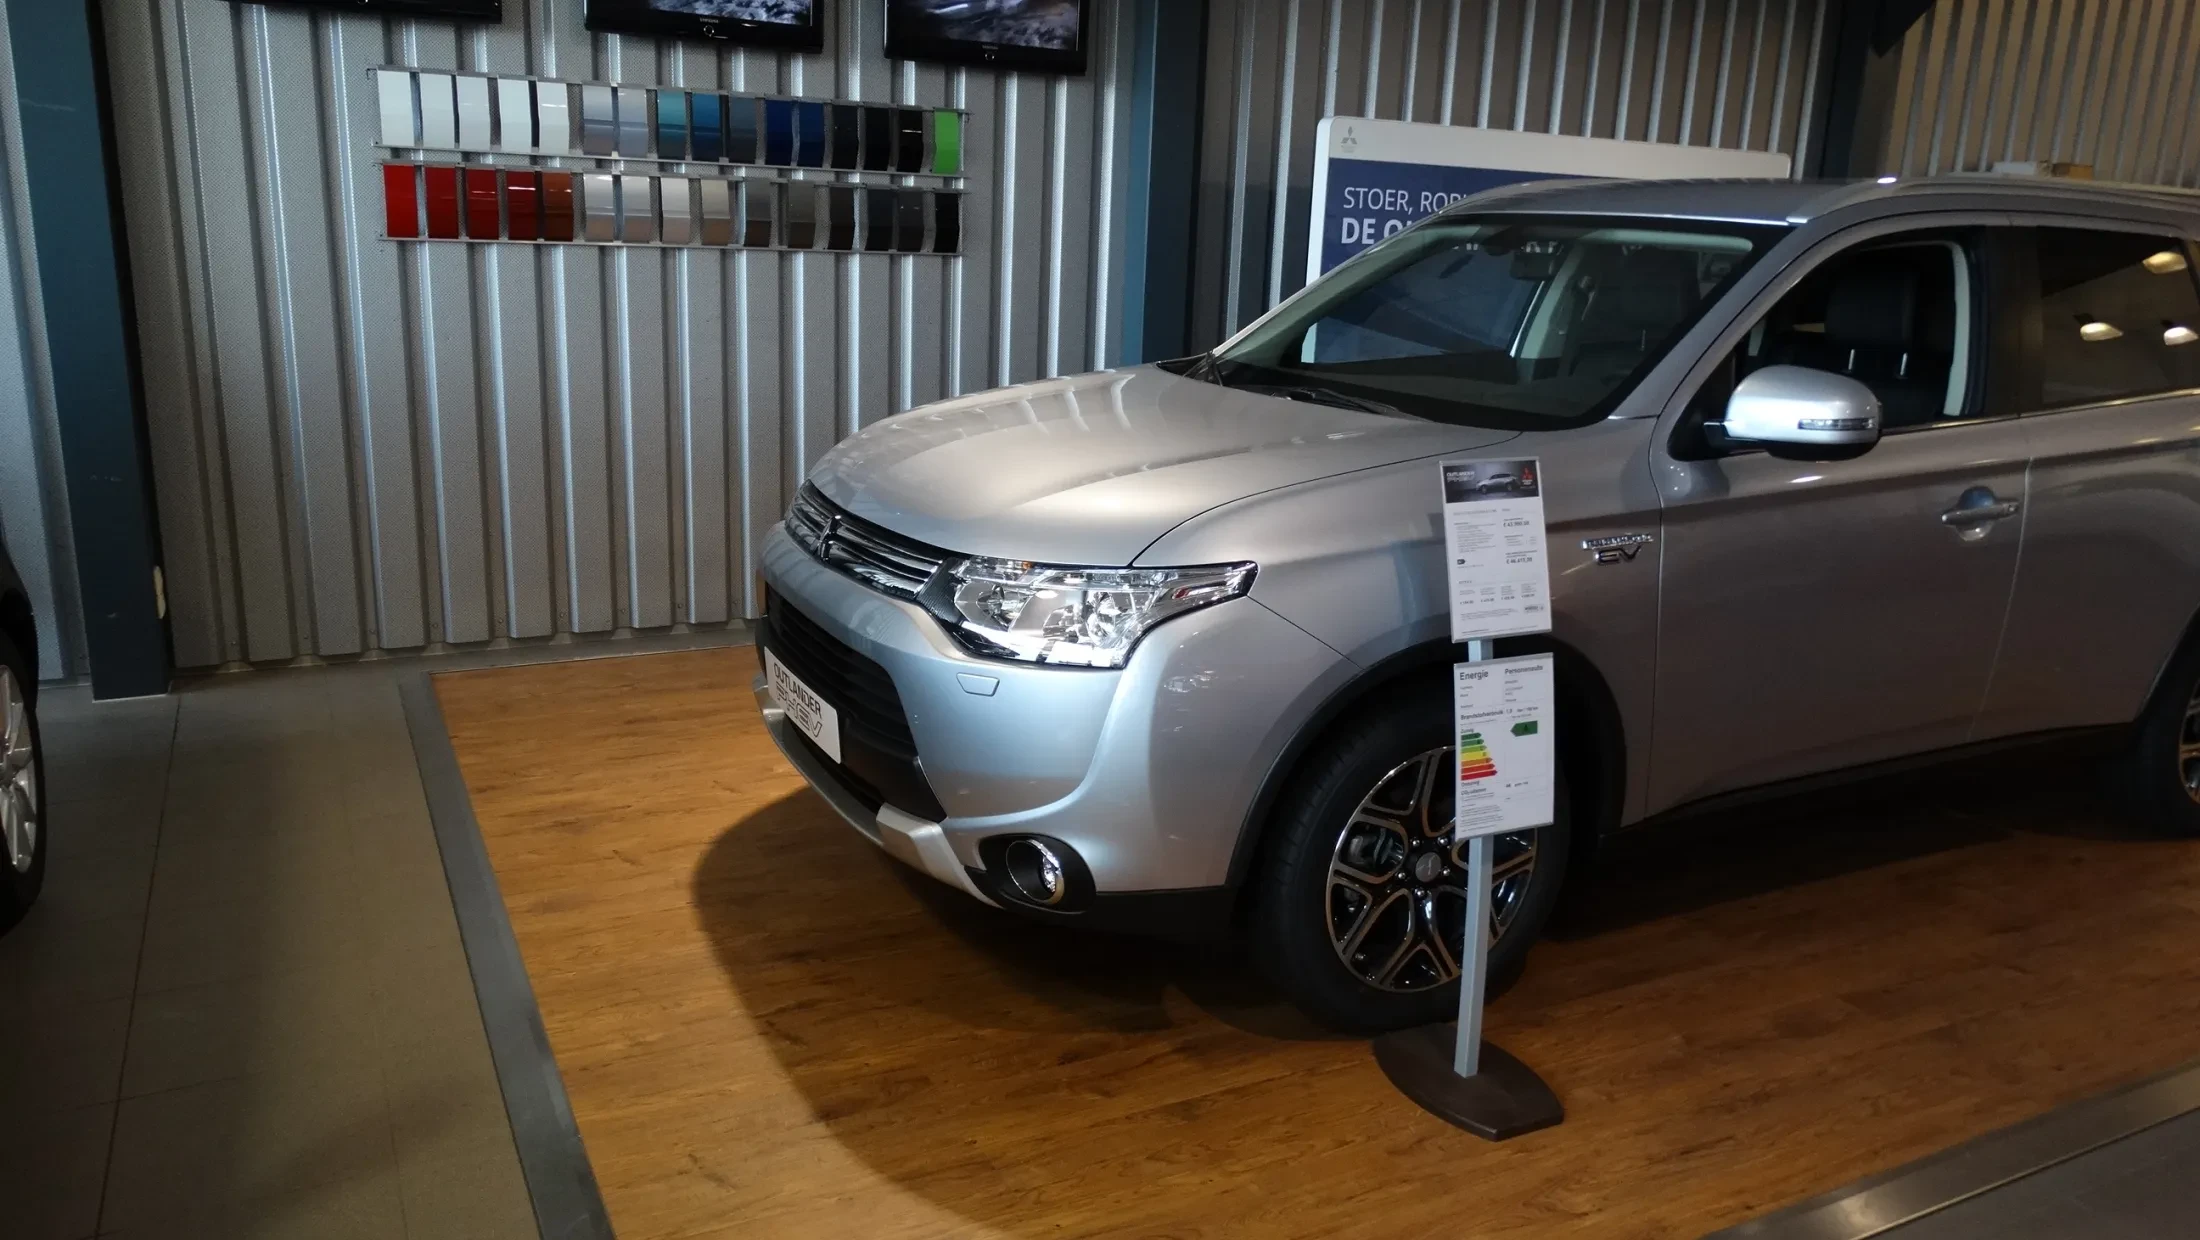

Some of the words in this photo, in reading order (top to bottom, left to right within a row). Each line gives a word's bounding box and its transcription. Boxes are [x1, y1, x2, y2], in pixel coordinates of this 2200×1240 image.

[1344, 187, 1413, 215] STOER,
[1341, 217, 1376, 245] DE
[1594, 546, 1642, 565] EV
[1460, 669, 1489, 681] Energie
[774, 663, 823, 719] OUTLANDER
